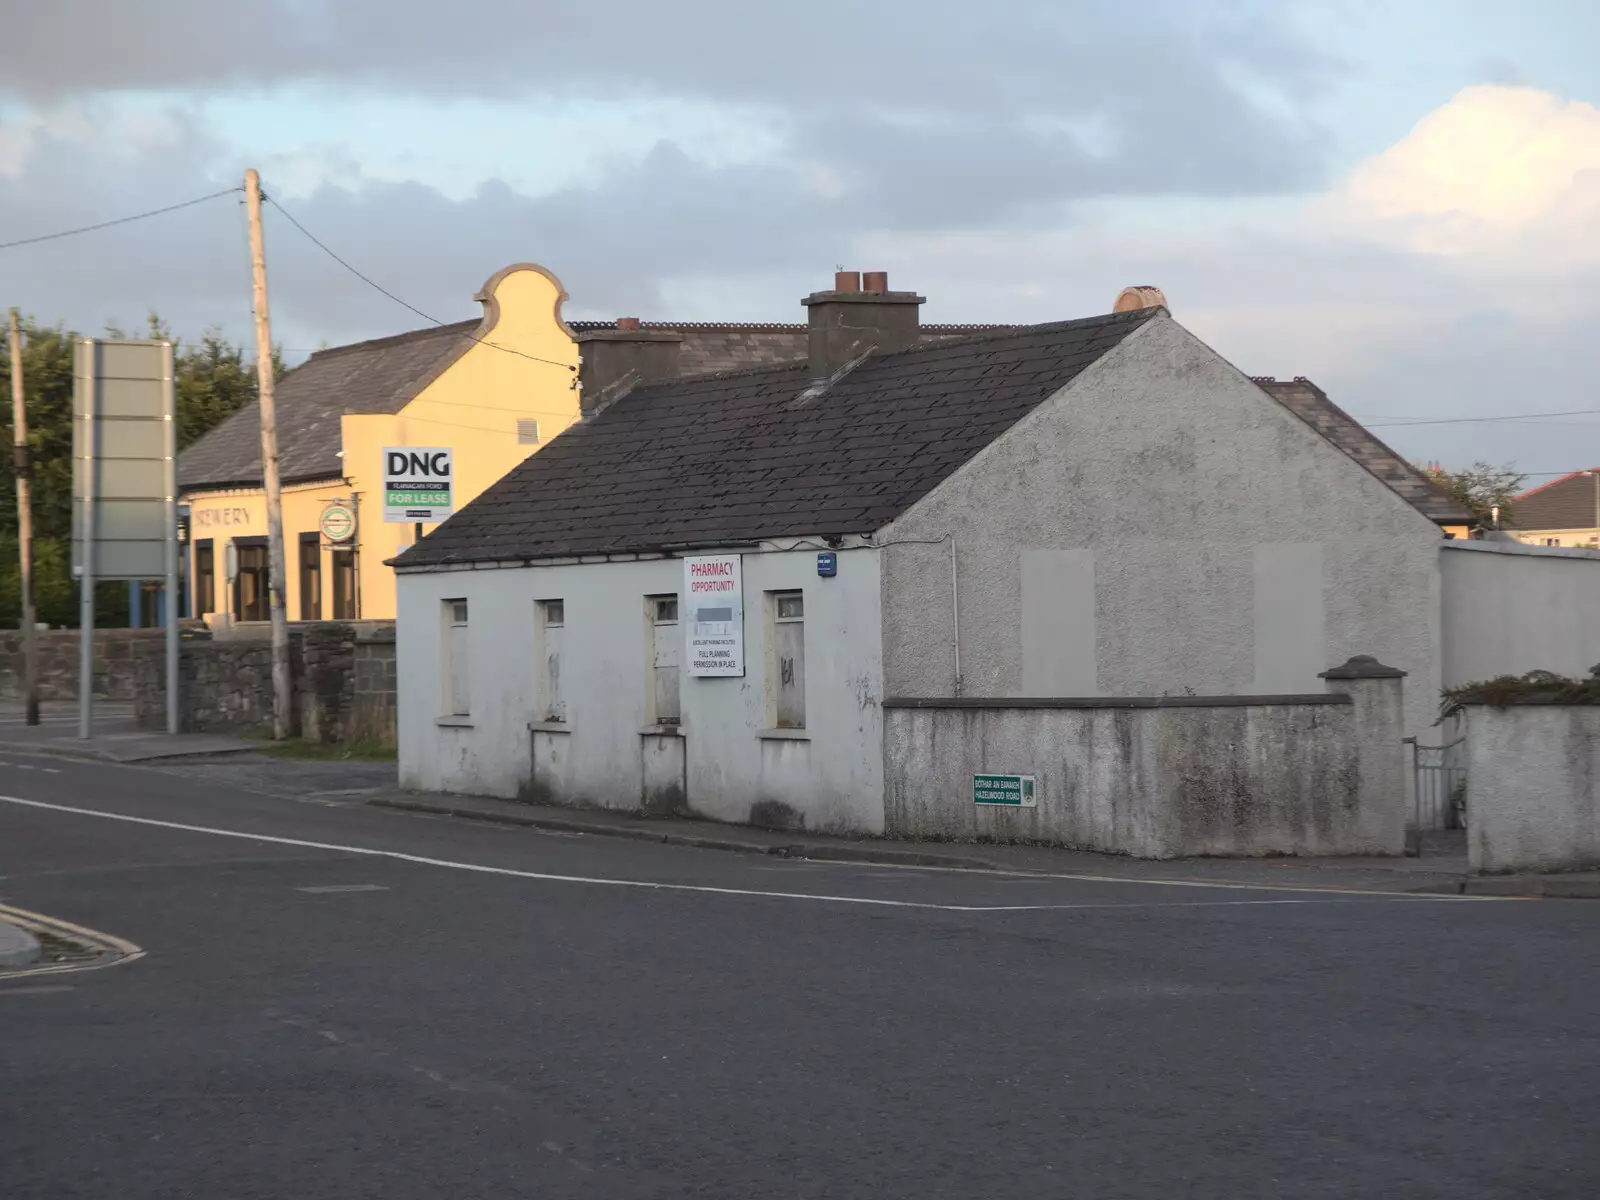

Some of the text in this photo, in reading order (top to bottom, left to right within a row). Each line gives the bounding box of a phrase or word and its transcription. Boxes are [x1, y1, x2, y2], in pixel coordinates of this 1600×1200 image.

[388, 452, 450, 476] DNG
[388, 493, 448, 504] FOR LEASE
[691, 562, 734, 576] PHARMACY
[692, 580, 734, 592] OPPORTUNITY
[698, 650, 730, 658] FULL PLANNING
[693, 660, 717, 668] PERMISSION
[723, 660, 736, 668] PLACE
[975, 790, 1020, 800] HAZELWOOD ROAD
